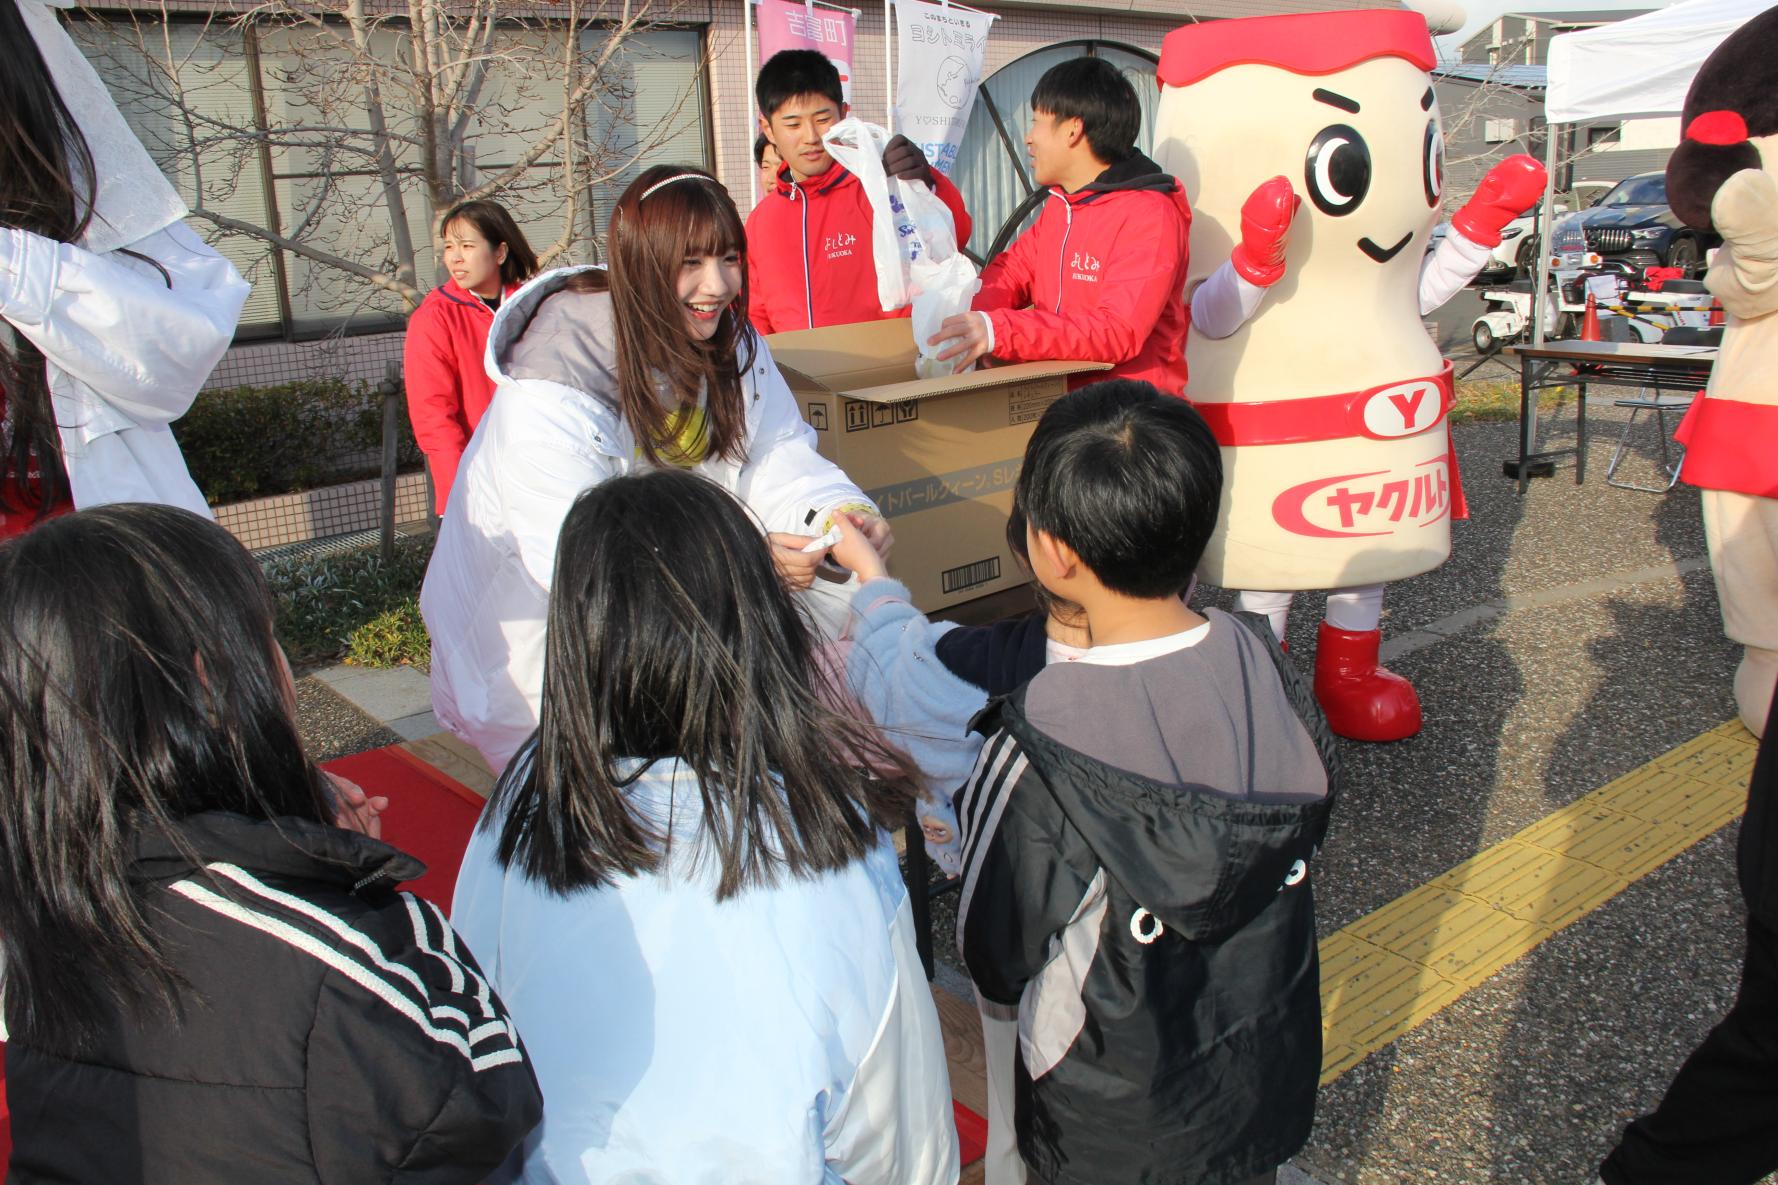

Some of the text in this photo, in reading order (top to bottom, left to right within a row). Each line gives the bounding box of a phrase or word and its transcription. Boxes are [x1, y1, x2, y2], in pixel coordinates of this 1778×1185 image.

[1388, 388, 1426, 429] Y
[1326, 468, 1448, 529] ヤクルト
